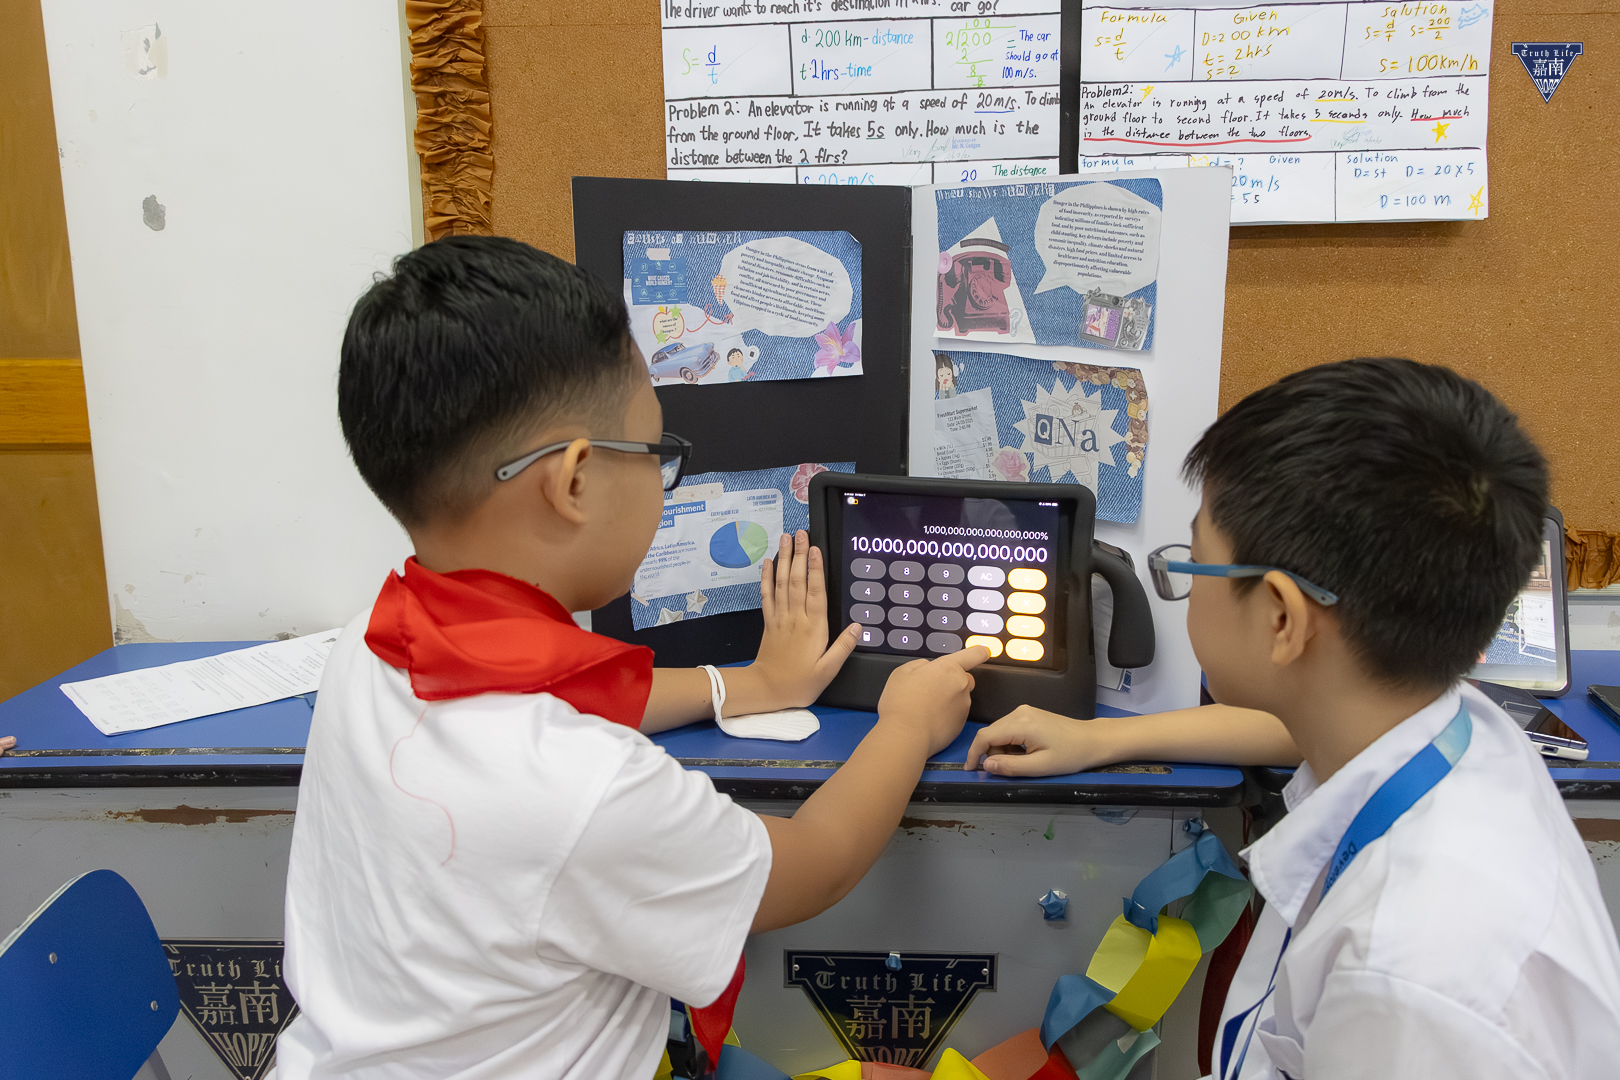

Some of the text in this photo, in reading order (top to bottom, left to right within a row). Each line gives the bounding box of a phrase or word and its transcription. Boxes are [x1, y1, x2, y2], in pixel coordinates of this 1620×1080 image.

[685, 0, 720, 18] driver
[723, 0, 752, 17] wants
[754, 0, 767, 15] to
[770, 0, 800, 14] reach
[951, 1, 970, 12] car
[1101, 11, 1168, 24] Formula
[1233, 10, 1278, 24] Given
[815, 28, 841, 48] 200
[872, 28, 914, 46] distance
[1020, 30, 1052, 42] The car
[1036, 53, 1048, 62] go
[1050, 50, 1059, 62] at
[1521, 49, 1574, 58] Truth Life
[1532, 58, 1564, 76] 嘉南
[1102, 99, 1143, 109] elevator
[1216, 92, 1232, 105] at
[1238, 96, 1246, 104] a
[1254, 90, 1284, 108] speed
[1296, 88, 1310, 99] of
[1365, 86, 1379, 98] To
[1386, 86, 1417, 100] climb
[1422, 84, 1448, 99] from
[1455, 82, 1470, 96] the
[668, 101, 720, 122] Problem
[764, 100, 814, 117] elevator
[820, 100, 829, 112] is
[836, 97, 878, 113] running
[883, 96, 896, 112] at
[902, 100, 910, 111] a
[919, 96, 946, 110] speed
[952, 93, 968, 110] of
[1025, 90, 1038, 106] To
[1082, 112, 1116, 126] ground
[1122, 112, 1148, 124] floor
[1152, 112, 1163, 124] to
[1176, 114, 1211, 125] second
[1256, 110, 1271, 122] It
[1278, 108, 1306, 120] takes
[1314, 108, 1321, 118] 5
[1328, 108, 1368, 120] seconds
[1411, 108, 1432, 120] How
[1442, 106, 1470, 118] much
[667, 126, 696, 143] from
[700, 124, 718, 141] the
[722, 128, 760, 144] ground
[803, 120, 822, 138] It
[826, 121, 862, 138] takes
[926, 120, 950, 138] How
[955, 120, 986, 136] much
[994, 120, 1006, 135] is
[1016, 120, 1040, 135] the
[1102, 126, 1116, 136] the
[1125, 127, 1171, 139] distance
[1178, 130, 1220, 141] between
[1226, 127, 1240, 138] the
[1248, 128, 1266, 138] two
[670, 148, 720, 166] distance
[726, 148, 772, 165] between
[775, 148, 793, 164] the
[800, 149, 810, 164] 2
[960, 170, 978, 183] 20
[992, 164, 1047, 178] The distance
[1036, 416, 1100, 453] QNa
[924, 526, 1048, 540] 1,000,000,000,000,000,000%
[852, 536, 1048, 562] 10,000,000,000,000,000
[904, 567, 910, 576] 8
[943, 570, 950, 578] 9
[980, 572, 992, 582] AC
[864, 588, 948, 601] 4 5 6
[902, 613, 908, 621] 2
[942, 616, 948, 624] 3
[902, 636, 908, 644] 0
[815, 970, 966, 993] Truth Life
[194, 981, 280, 1026] 嘉南
[844, 994, 936, 1040] 嘉南
[210, 1032, 276, 1067] HOPE
